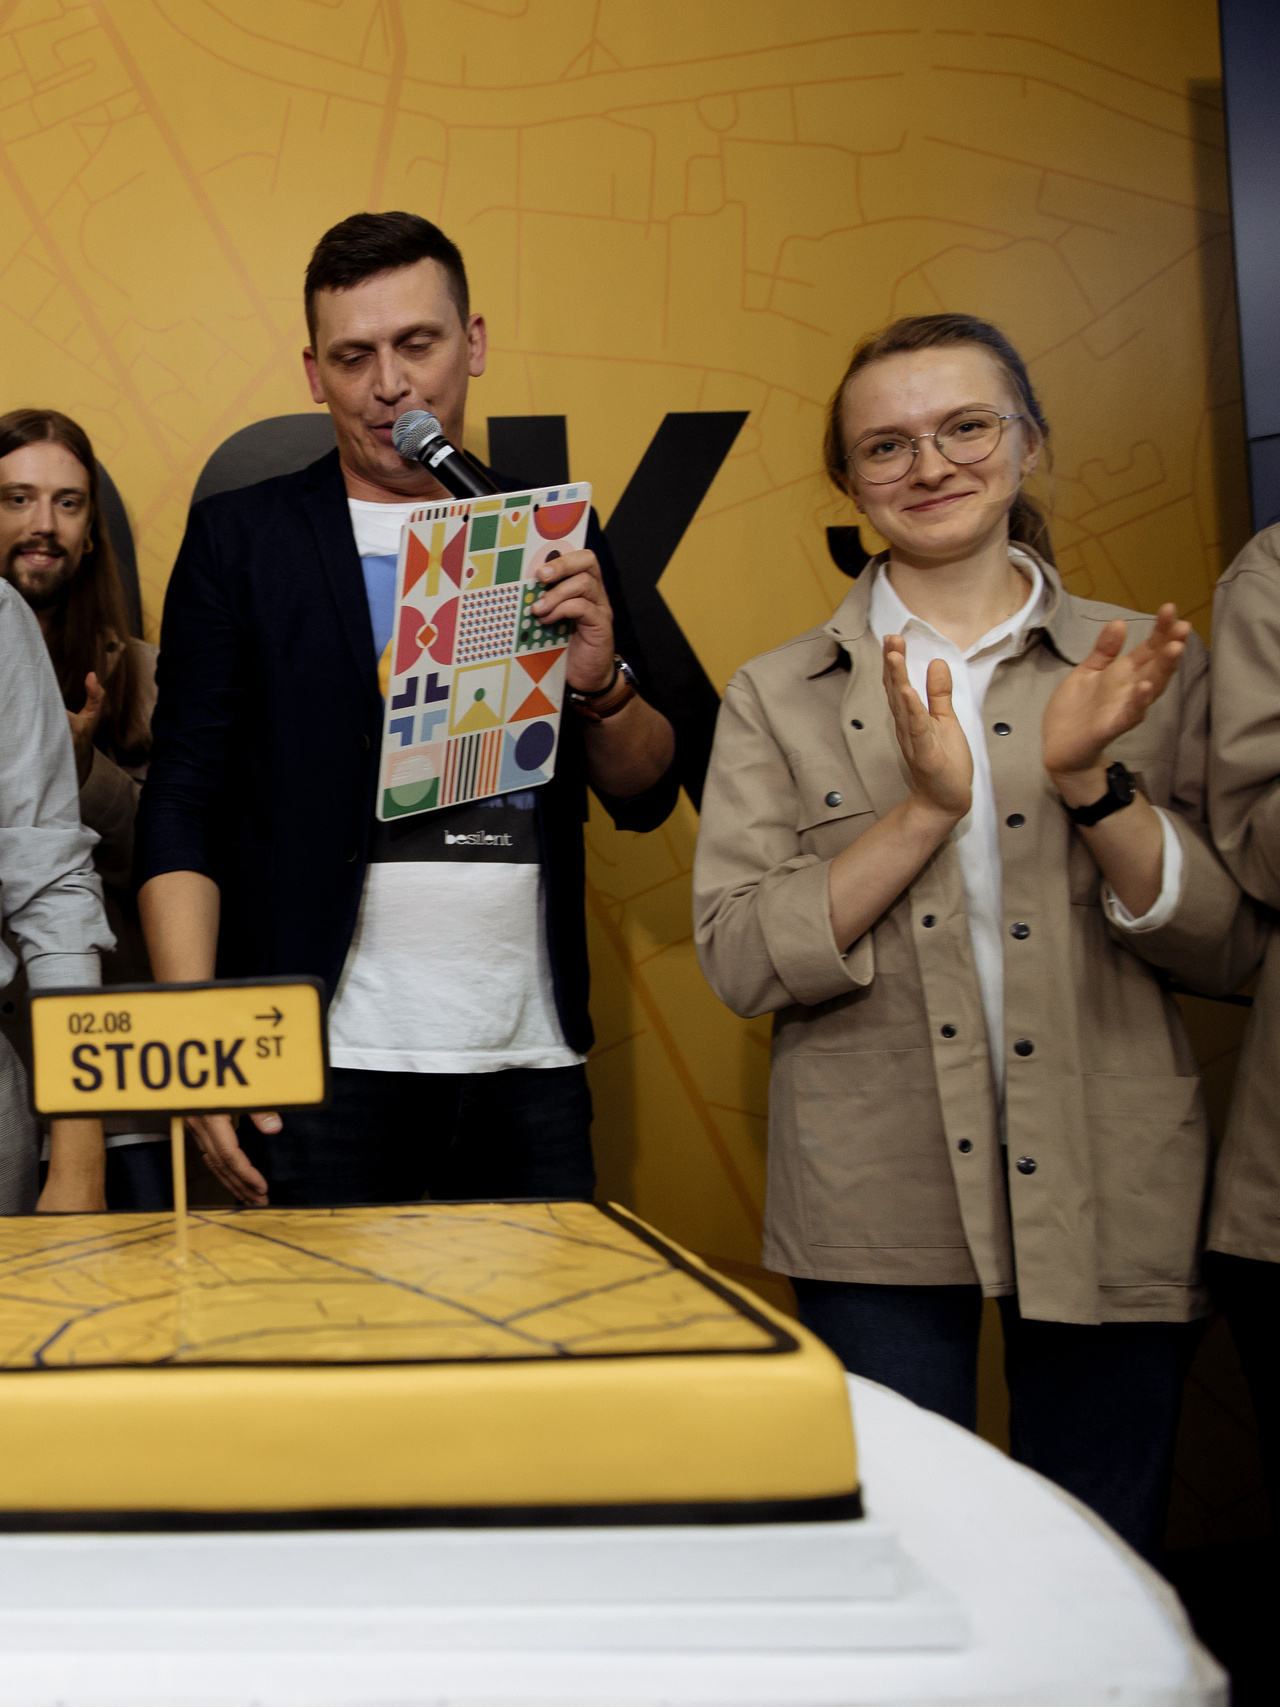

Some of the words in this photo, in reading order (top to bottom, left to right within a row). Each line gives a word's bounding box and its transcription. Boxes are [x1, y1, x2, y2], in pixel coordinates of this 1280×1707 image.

[68, 1012, 132, 1034] 02.08
[71, 1038, 249, 1091] STOCK
[255, 1036, 284, 1058] ST
